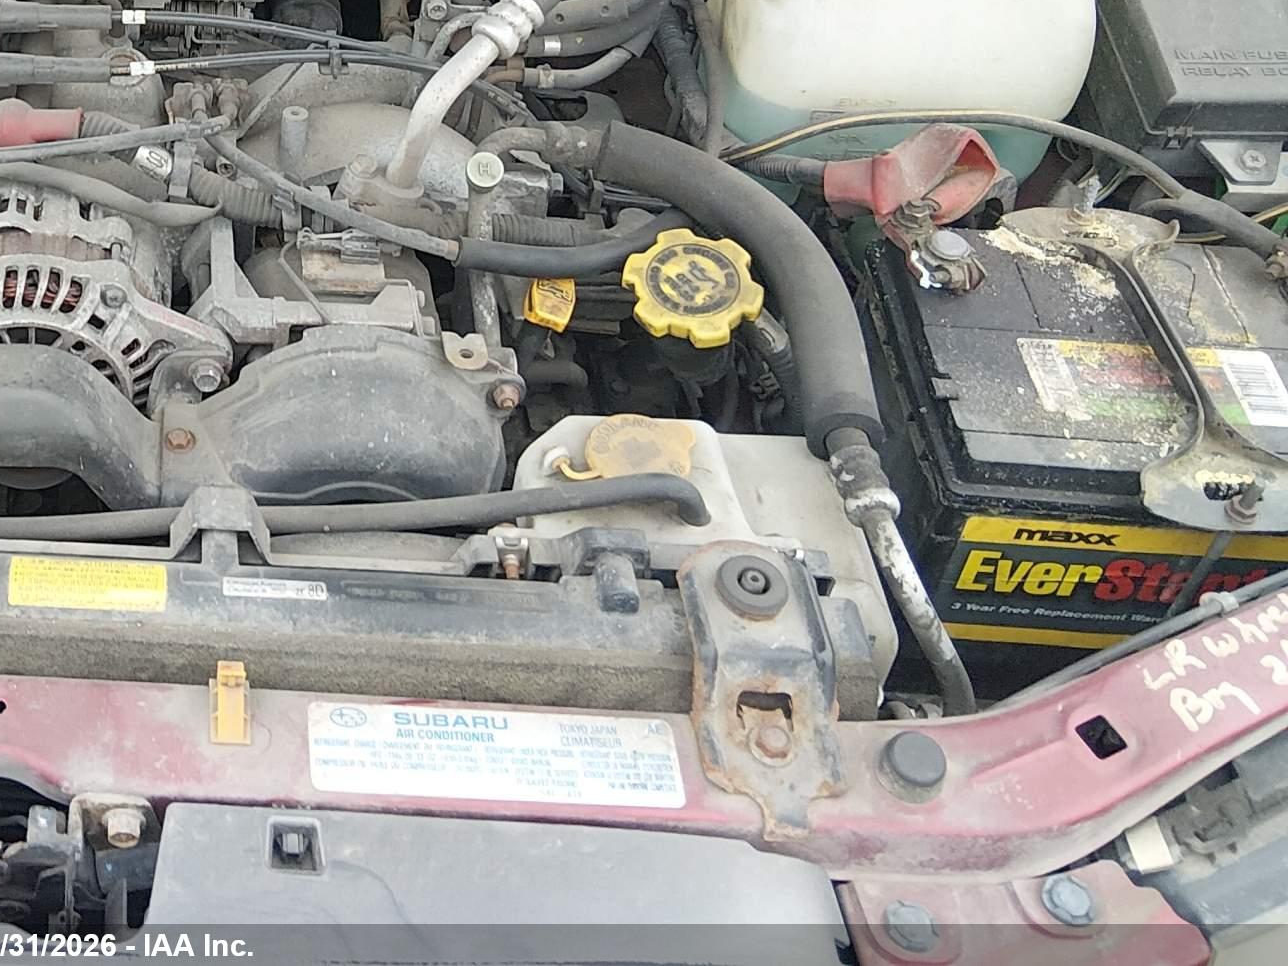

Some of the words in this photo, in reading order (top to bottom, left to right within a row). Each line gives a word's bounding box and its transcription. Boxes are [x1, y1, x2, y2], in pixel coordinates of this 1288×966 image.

[1173, 49, 1240, 60] MAIN
[1180, 66, 1253, 77] RELAY
[1013, 528, 1121, 547] maxx
[951, 603, 962, 611] 3
[965, 603, 996, 613] Year
[998, 605, 1031, 615] Free
[1033, 607, 1126, 622] Replacement
[393, 712, 509, 730] SUBARU
[395, 728, 415, 739] AIR
[417, 729, 495, 743] CONDITIONER
[560, 736, 623, 747] CLIMATISEUR
